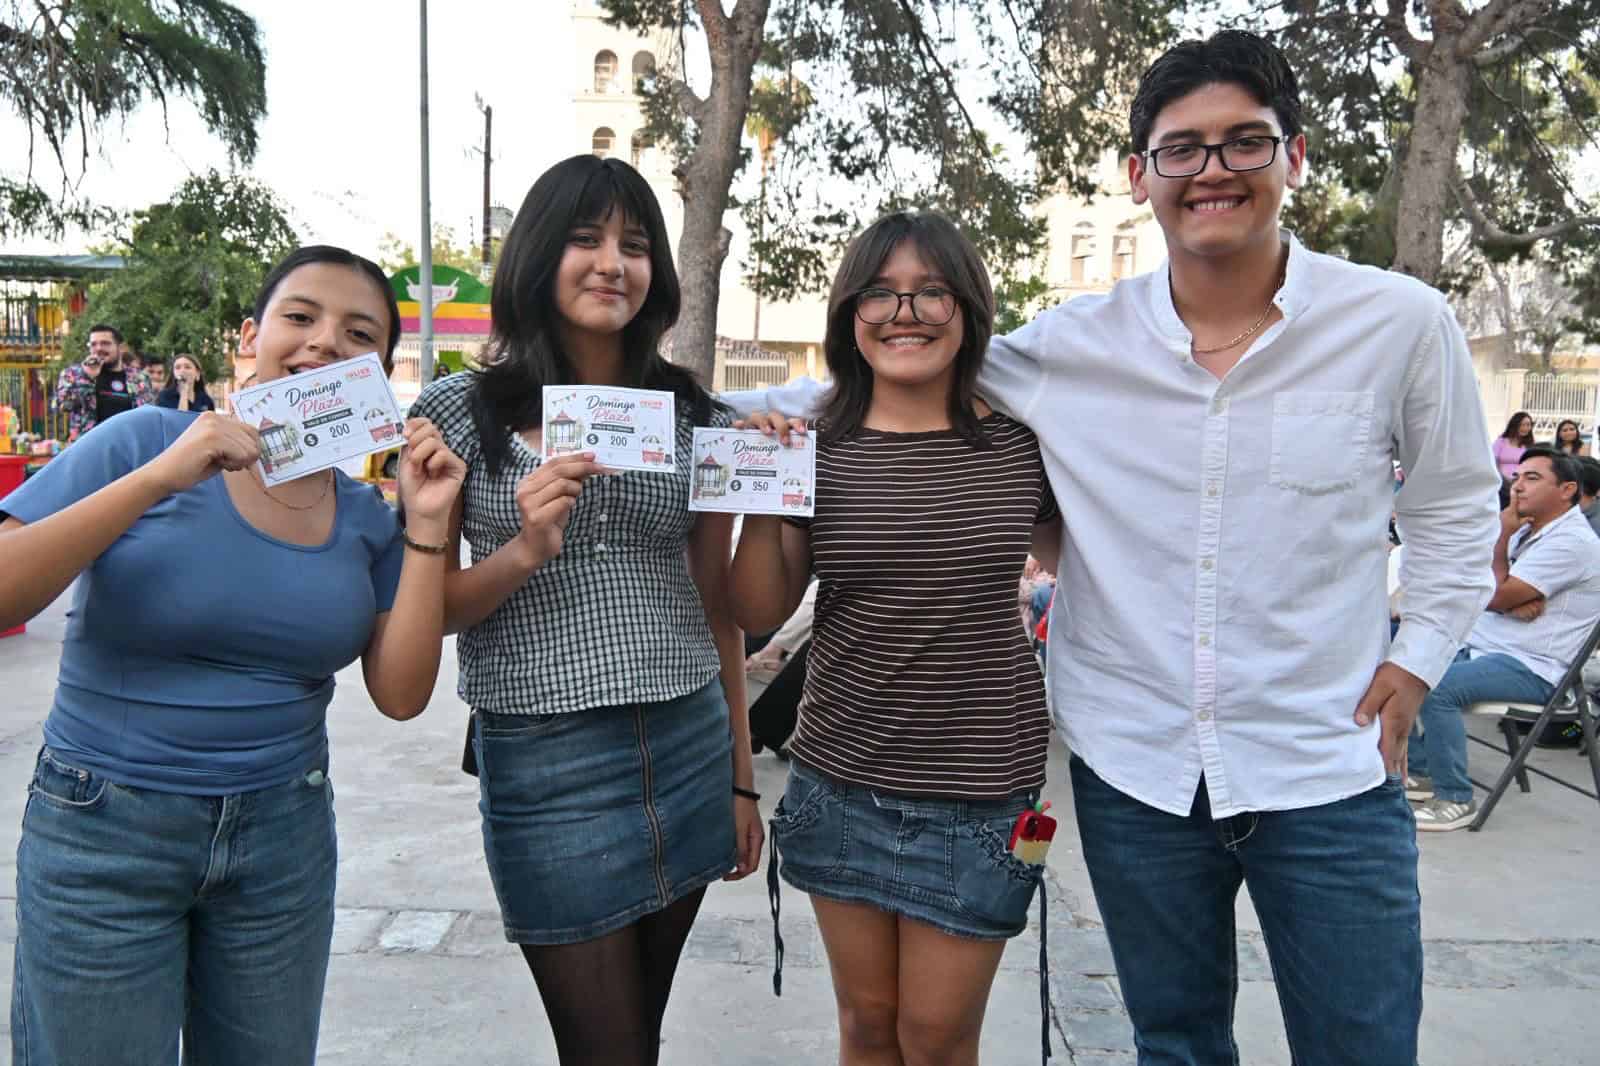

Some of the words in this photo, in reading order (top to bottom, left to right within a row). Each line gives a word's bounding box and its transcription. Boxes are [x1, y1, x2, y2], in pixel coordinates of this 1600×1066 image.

[285, 380, 342, 407] Domingo
[298, 397, 345, 419] Plaza
[586, 395, 635, 413] Domingo
[592, 409, 632, 423] Plaza
[329, 423, 350, 439] 200
[610, 435, 628, 447] 200
[732, 439, 779, 456] Domingo
[737, 453, 776, 465] Plaza
